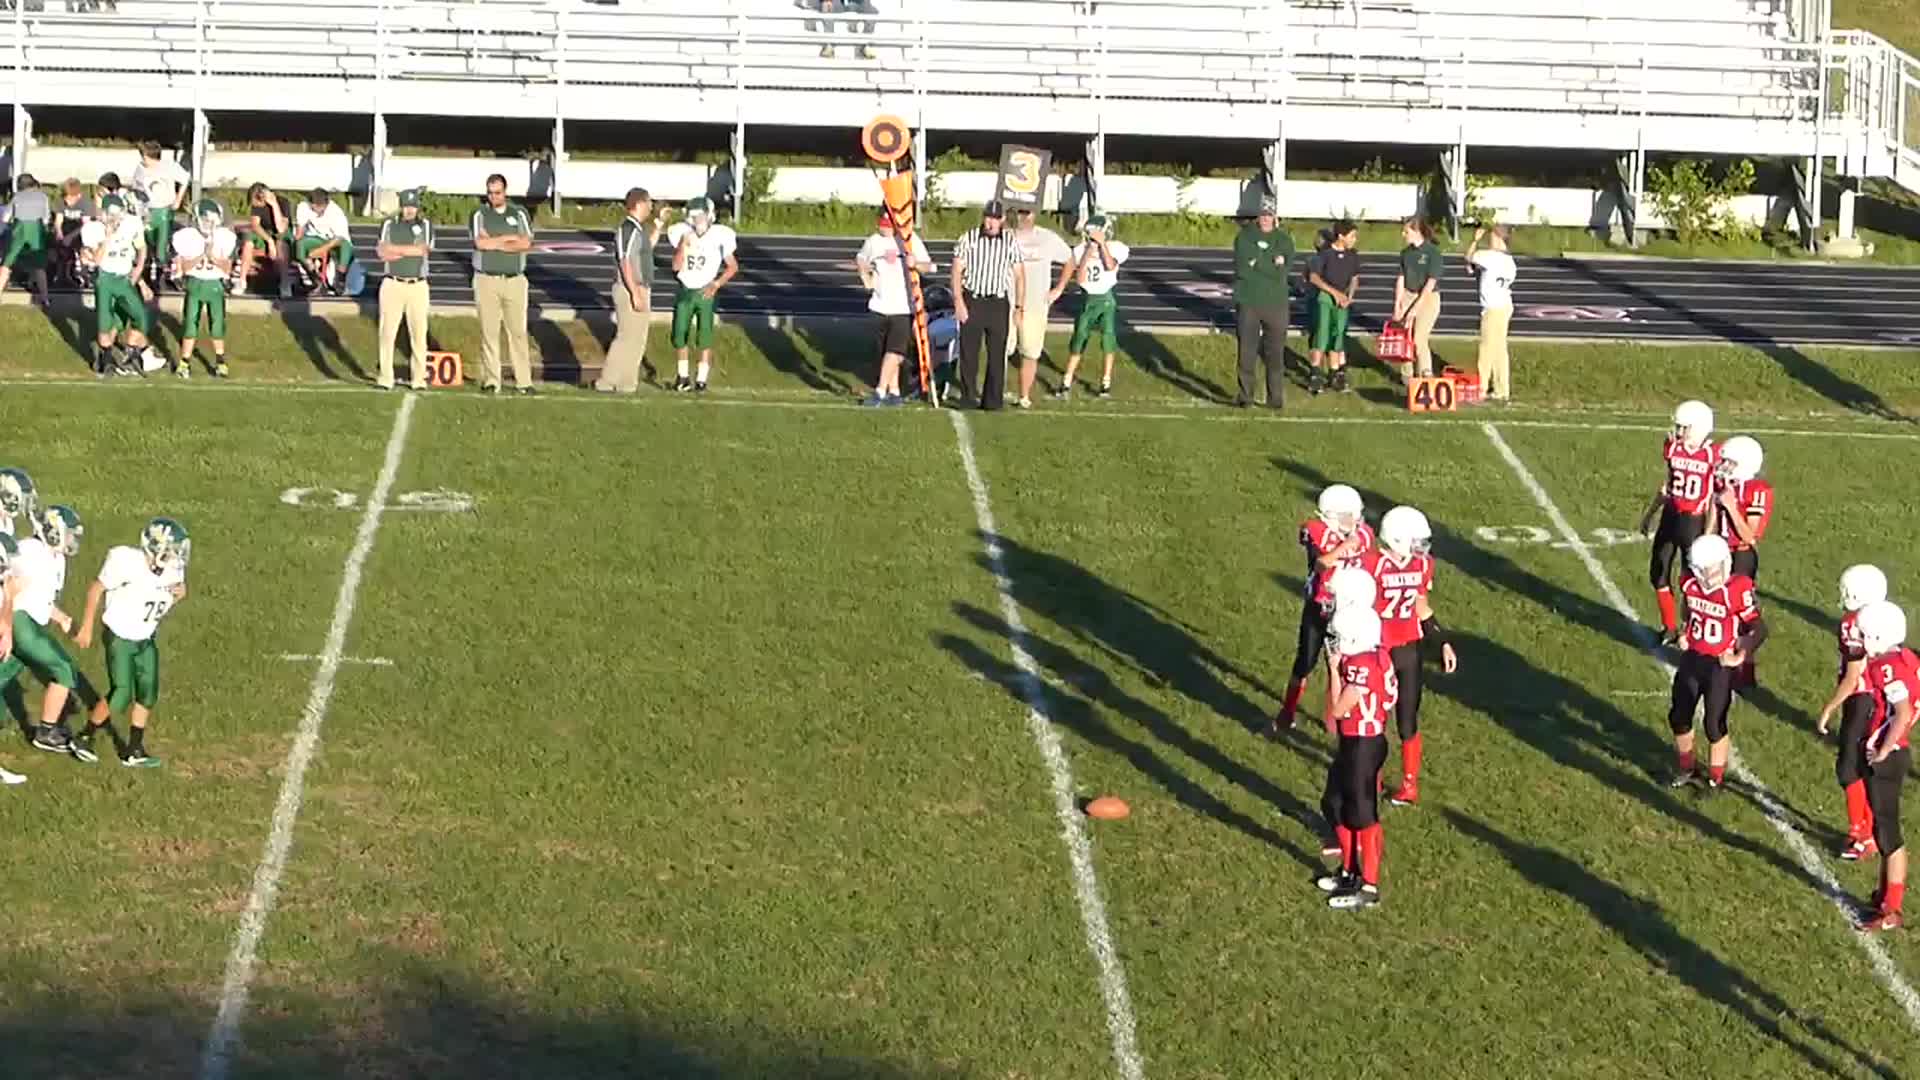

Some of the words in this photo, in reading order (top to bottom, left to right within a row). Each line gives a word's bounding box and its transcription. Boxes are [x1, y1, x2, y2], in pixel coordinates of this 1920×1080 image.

[1004, 151, 1041, 193] 3
[1414, 381, 1452, 410] 40
[1671, 470, 1703, 500] 20
[1380, 588, 1419, 619] 72
[1688, 611, 1722, 644] 60
[1345, 665, 1369, 684] 52
